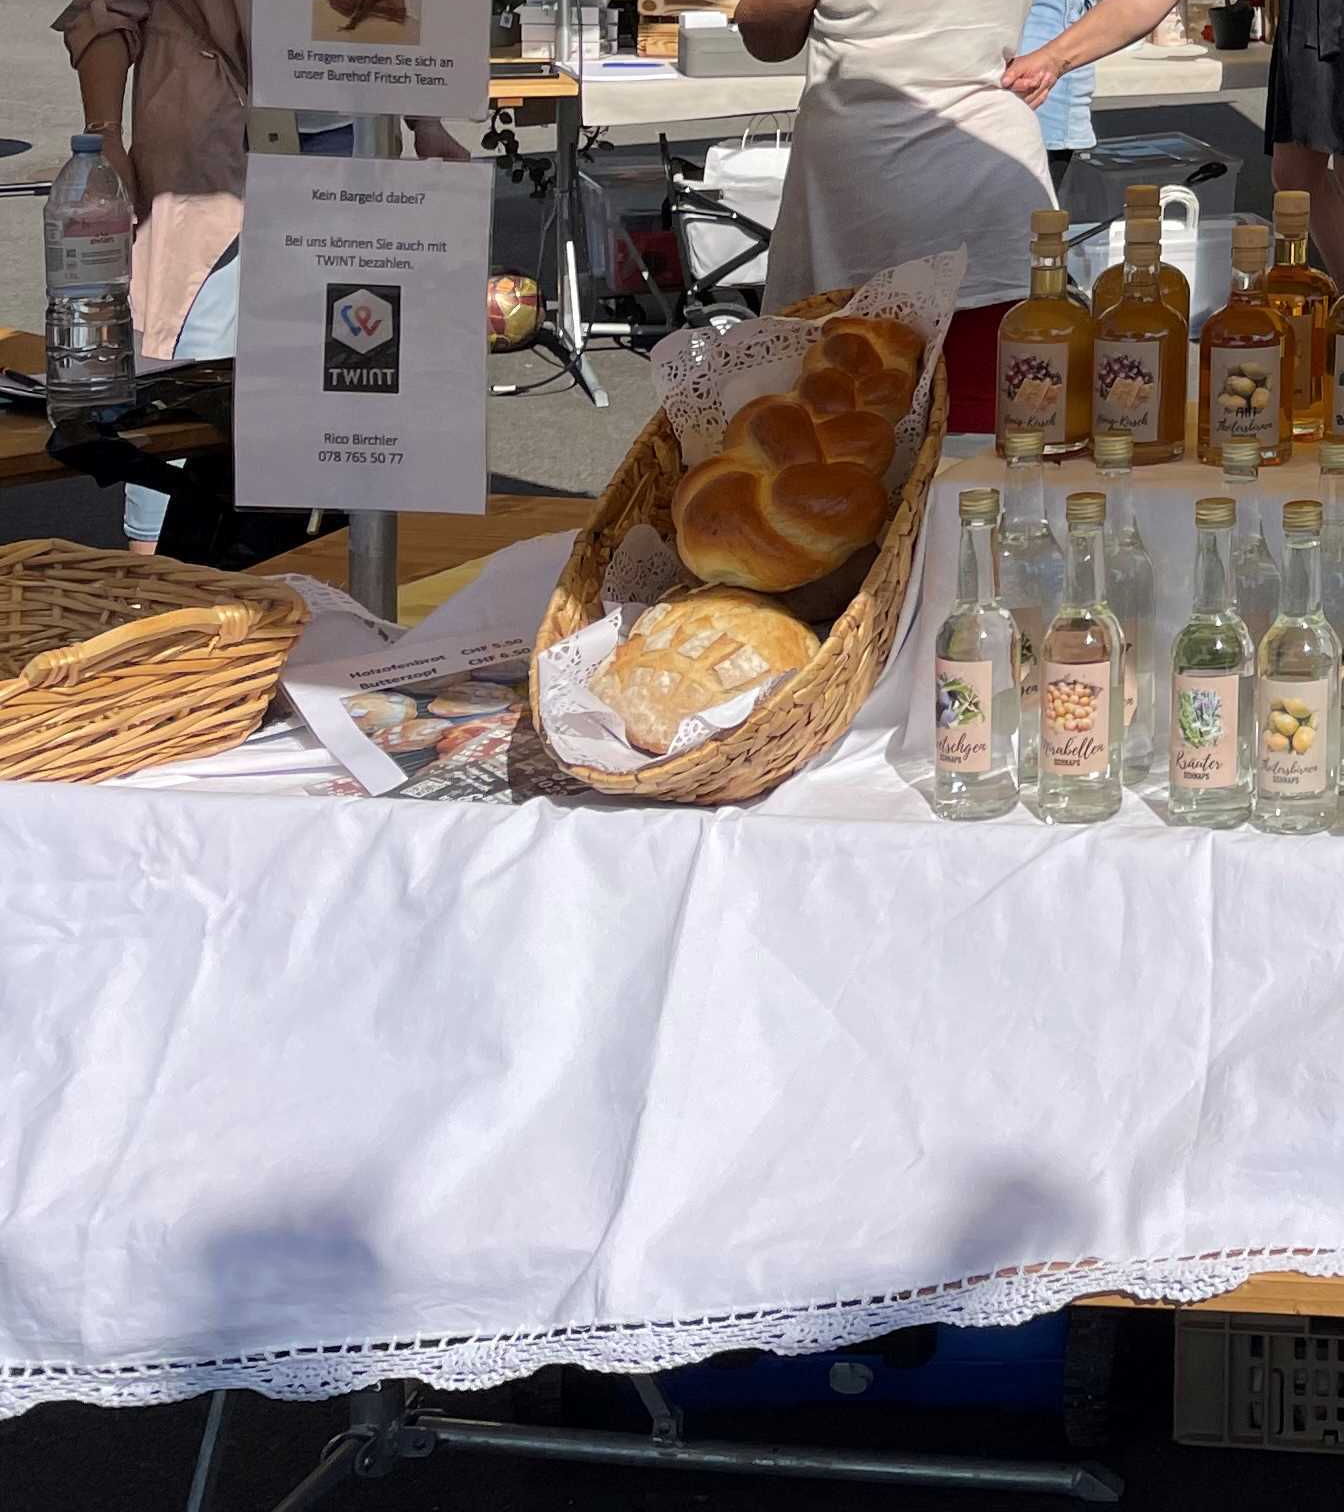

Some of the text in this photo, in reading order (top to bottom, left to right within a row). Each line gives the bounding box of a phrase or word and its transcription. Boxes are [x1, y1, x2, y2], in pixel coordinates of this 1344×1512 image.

[287, 49, 453, 68] Bei Fragen wenden Sie sich an
[294, 70, 448, 86] unser Burehof Fritsch Team.
[312, 189, 426, 205] Kein Bargeld dabei?
[285, 235, 447, 253] Bei uns können Sie auch mit
[315, 256, 413, 270] TWINT bezahlen.
[328, 369, 395, 386] TWINT
[324, 433, 349, 445] Rico
[318, 450, 404, 465] 078 765 50 77
[349, 655, 446, 679] Holzofenbrot
[461, 645, 488, 656] CHF
[360, 668, 438, 690] Butterzopf
[468, 656, 497, 666] CHF
[1176, 752, 1223, 771] Kräuter
